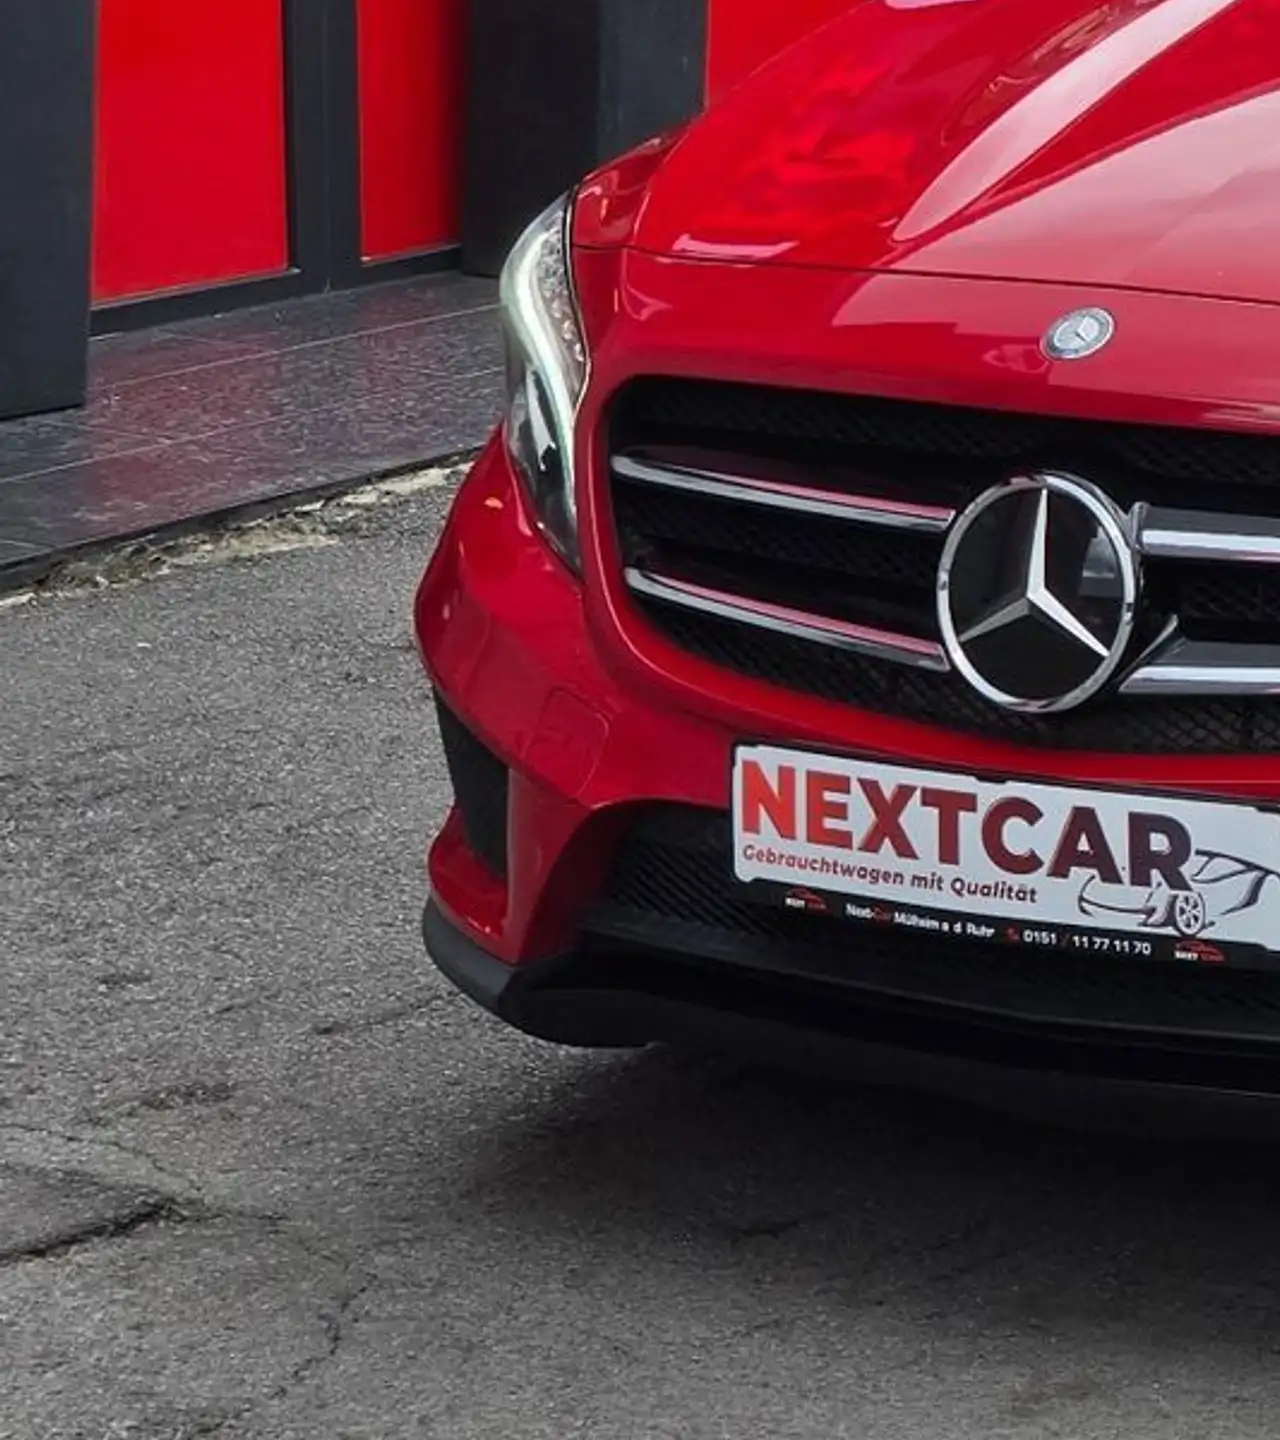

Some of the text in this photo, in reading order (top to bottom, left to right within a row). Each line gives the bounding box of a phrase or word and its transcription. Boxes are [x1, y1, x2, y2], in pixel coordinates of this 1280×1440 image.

[742, 759, 1193, 892] NEXTCAR
[743, 844, 1037, 903] Gebrauchtwagen mit Qualität
[1022, 929, 1057, 945] 0151
